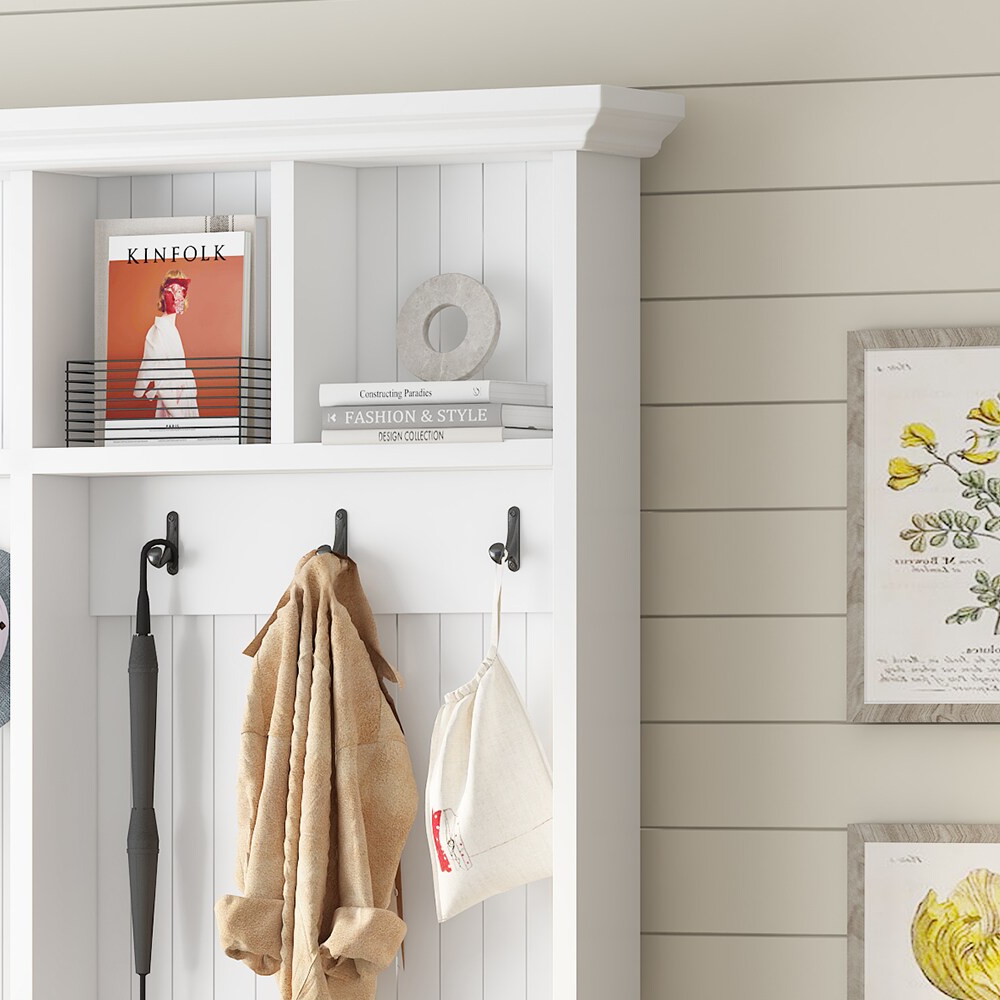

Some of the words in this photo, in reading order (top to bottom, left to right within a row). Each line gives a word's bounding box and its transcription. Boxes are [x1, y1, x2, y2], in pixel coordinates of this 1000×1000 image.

[127, 244, 226, 264] KINFOLK
[359, 390, 402, 400] Constructing
[404, 389, 432, 398] Paradies
[345, 409, 417, 424] FASHION
[421, 409, 433, 423] &
[437, 408, 488, 423] STYLE
[378, 430, 403, 442] DESIGN
[404, 430, 444, 441] COLLECTION
